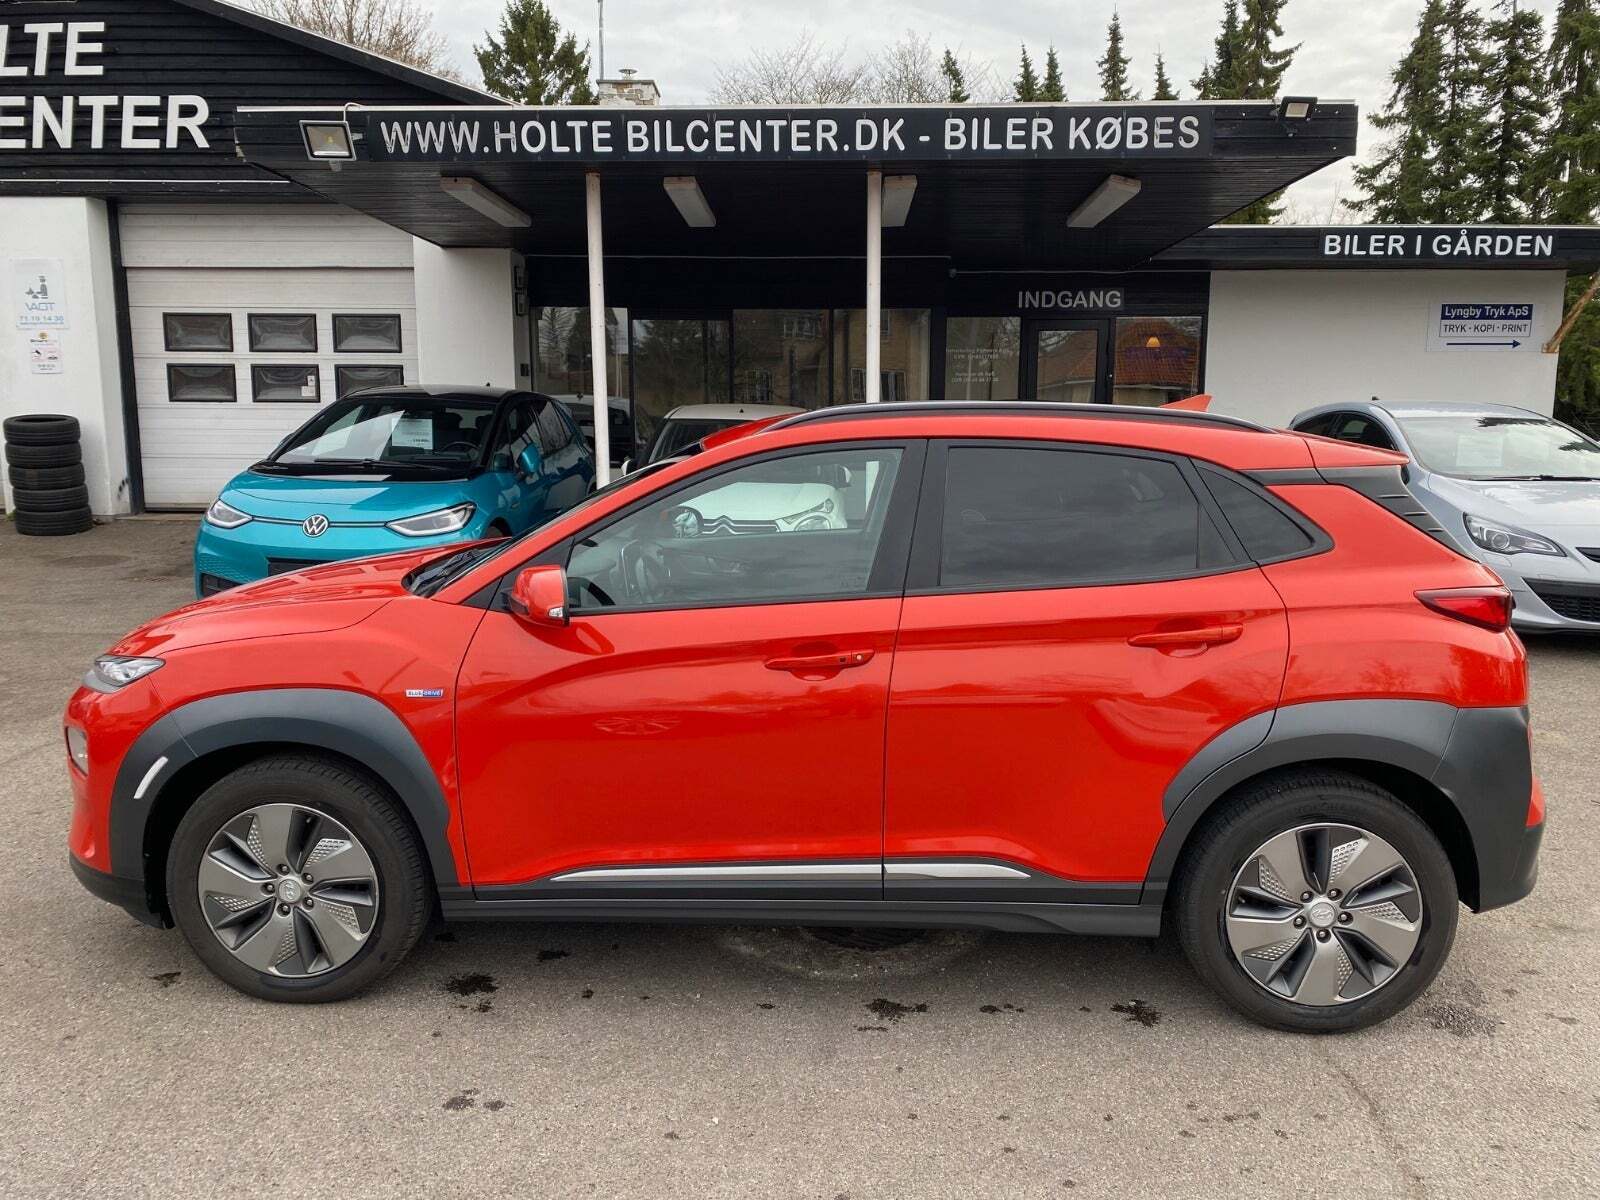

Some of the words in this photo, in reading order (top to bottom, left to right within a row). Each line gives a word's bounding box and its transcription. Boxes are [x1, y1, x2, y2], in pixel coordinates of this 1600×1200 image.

[380, 120, 613, 154] WWW.HOLTE
[626, 118, 906, 153] BILCENTER.DK
[944, 117, 1054, 151] BILER
[1068, 115, 1200, 150] KØBES
[1324, 234, 1405, 256] BILER
[1415, 234, 1422, 256] I
[1432, 229, 1553, 256] GÅRDEN
[1018, 290, 1122, 309] INDGANG
[1445, 306, 1482, 319] Lyngby
[1485, 306, 1506, 318] Tryk
[1507, 306, 1529, 318] ApS
[1444, 324, 1466, 333] TRYK
[1474, 324, 1495, 333] KOPI
[1502, 324, 1528, 333] PRINT
